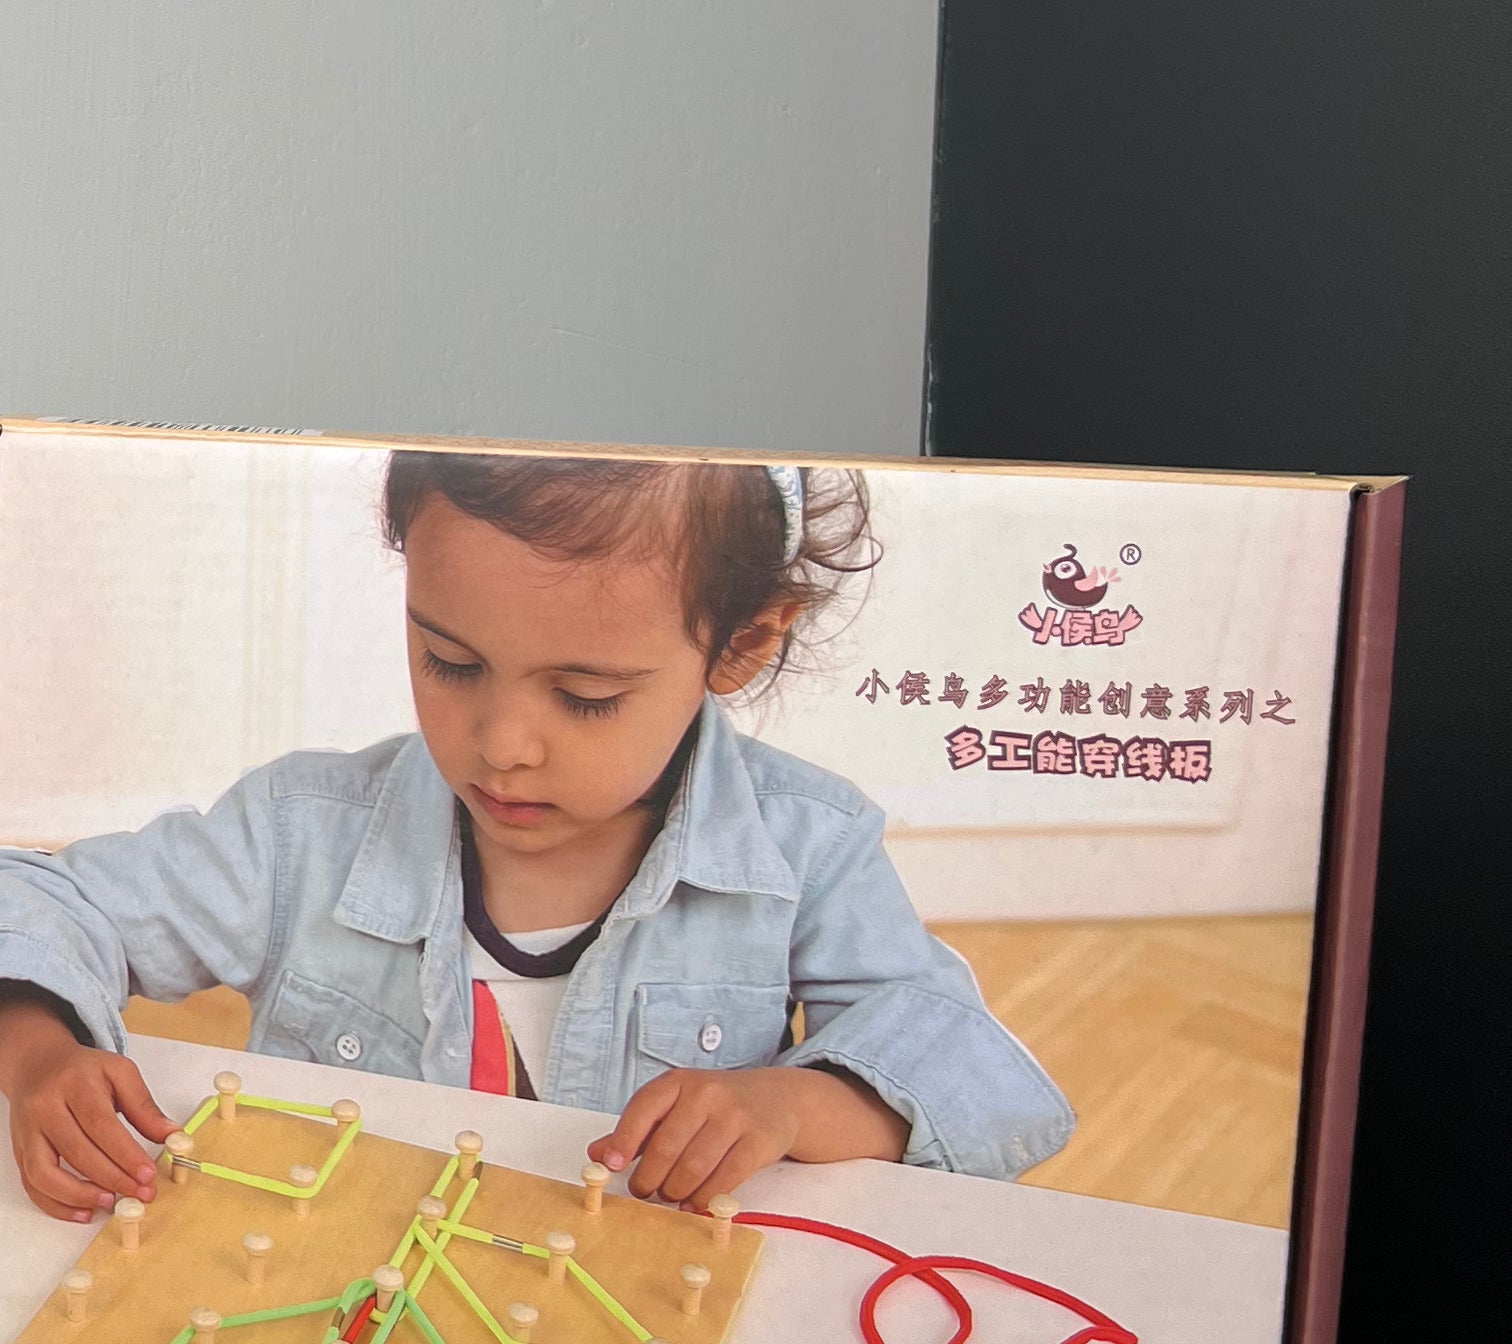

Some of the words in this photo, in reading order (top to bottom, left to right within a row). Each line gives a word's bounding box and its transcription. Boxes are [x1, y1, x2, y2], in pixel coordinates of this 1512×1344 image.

[944, 724, 1212, 783] 多工能穿线板
